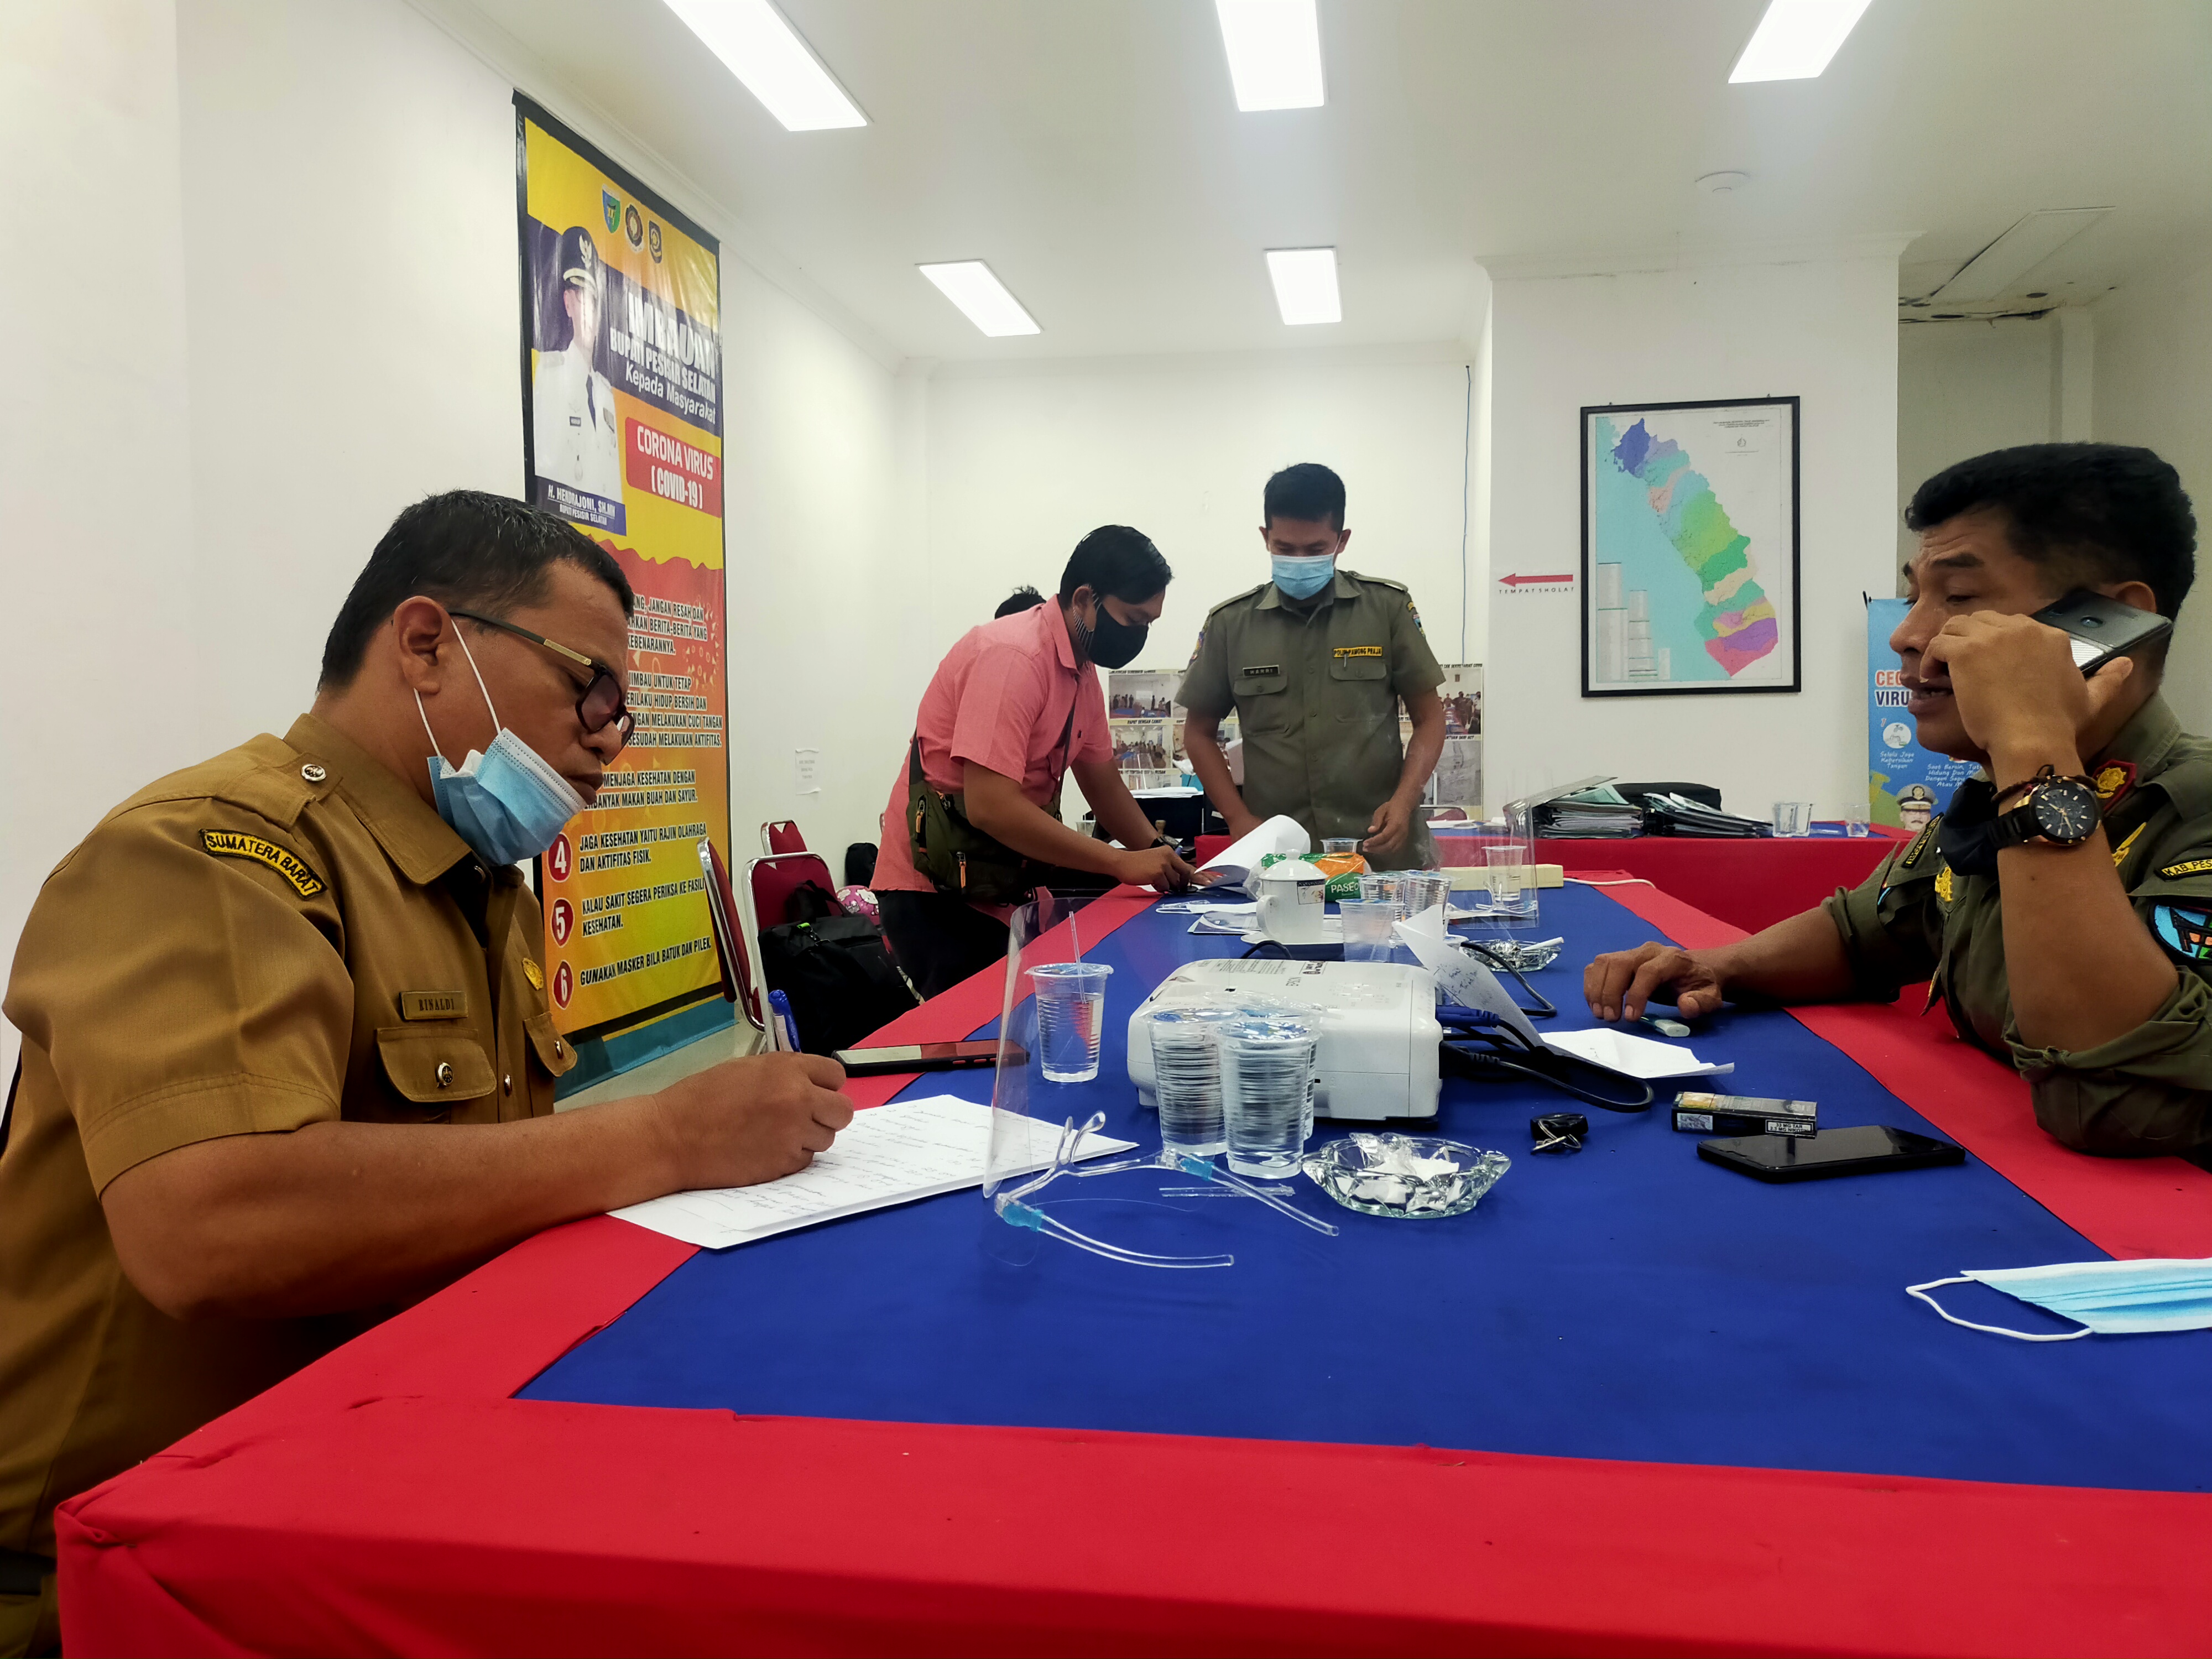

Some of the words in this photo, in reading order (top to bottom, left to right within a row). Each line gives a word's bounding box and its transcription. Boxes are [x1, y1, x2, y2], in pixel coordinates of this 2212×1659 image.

[610, 327, 644, 367] BUPATI
[646, 347, 681, 385] PESISIR
[681, 366, 716, 404] SELATAN
[625, 360, 664, 399] Kepada
[666, 382, 716, 424] Masyarakat
[637, 425, 683, 468] CORONA
[684, 446, 714, 481] VIRUS
[548, 484, 555, 499] H.
[556, 487, 597, 514] HENDRAJONI,
[572, 508, 589, 521] PESISIR
[590, 513, 607, 526] SELATAN
[648, 598, 672, 615] JANGAN
[673, 603, 692, 619] RESAH
[692, 607, 704, 621] DAN
[649, 618, 692, 638] BERITA-BERITA
[693, 626, 707, 640] YANG
[654, 674, 674, 690] UNTUK
[674, 676, 691, 690] TETAP
[654, 695, 672, 708] HIDUP
[674, 696, 695, 709] BERSIH
[696, 697, 707, 709] DAN
[651, 713, 687, 727] MELAKUKAN
[688, 714, 702, 728] CUCI
[703, 716, 723, 729] TANGAN
[659, 733, 693, 747] MELAKUKAN
[695, 733, 722, 746] AKTIFITAS.
[637, 771, 671, 786] KESEHATAN
[673, 770, 696, 784] DENGAN
[622, 792, 644, 807] MAKAN
[646, 791, 663, 805] BUAH
[665, 790, 676, 804] DAN
[678, 789, 698, 802] SAYUR.
[580, 835, 598, 851] JAGA
[601, 831, 638, 848] KESEHATAN
[640, 828, 658, 844] YAITU
[659, 826, 676, 841] RAJIN
[678, 823, 707, 838] OLAHRAGA
[207, 834, 281, 864] SUMATERA
[279, 857, 320, 892] BARAT
[554, 841, 567, 874] 4
[580, 857, 595, 873] DAN
[597, 852, 631, 870] AKTIFITAS
[633, 849, 651, 864] FISIK.
[582, 898, 603, 915] KALAU
[606, 893, 625, 910] SAKIT
[627, 888, 651, 906] SEGERA
[654, 883, 678, 900] PERIKSA
[680, 881, 686, 894] KE
[1331, 881, 1359, 894] PASEO
[555, 906, 566, 941] 5
[583, 914, 623, 936] KESEHATAN.
[581, 963, 617, 985] GUNAKAN
[617, 955, 644, 974] MASKER
[646, 951, 660, 967] BILA
[662, 945, 680, 962] BATUK
[682, 941, 692, 956] DAN
[560, 968, 568, 1002] 6
[418, 998, 455, 1011] RINALDI
